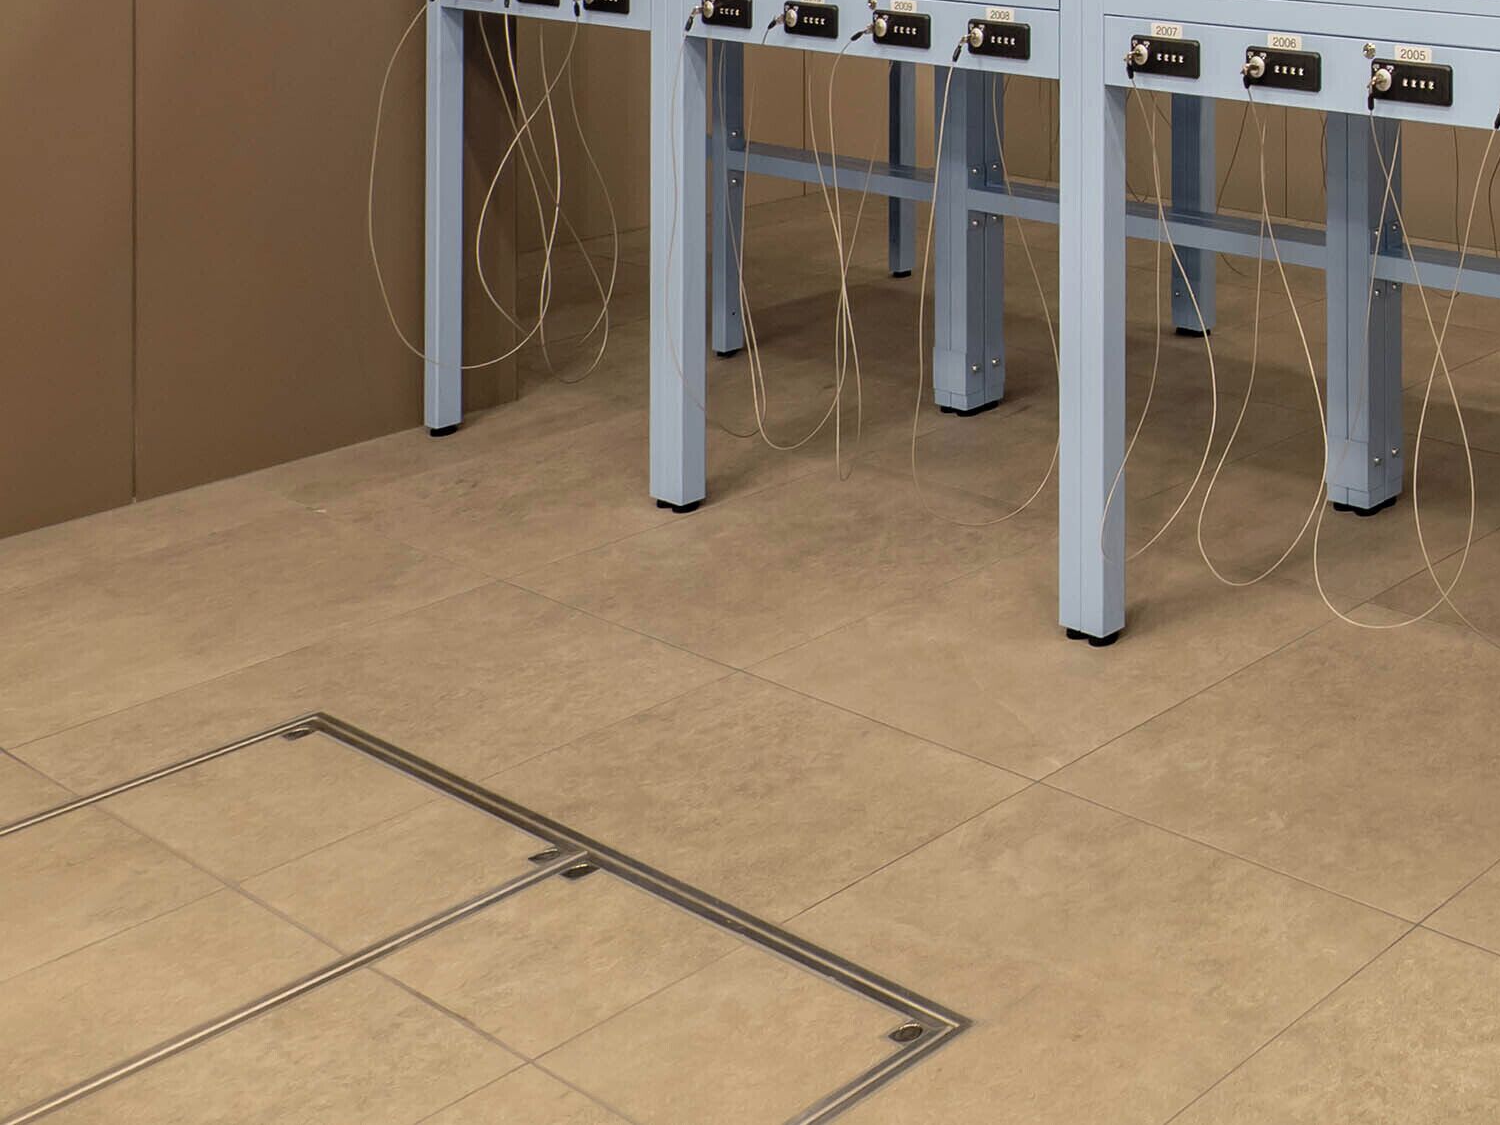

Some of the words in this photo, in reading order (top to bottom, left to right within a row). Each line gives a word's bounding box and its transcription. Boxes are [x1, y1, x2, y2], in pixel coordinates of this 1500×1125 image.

[894, 1, 913, 12] 2009
[1155, 25, 1178, 37] 2007
[1272, 37, 1297, 49] 2006
[1400, 48, 1426, 60] 2005
